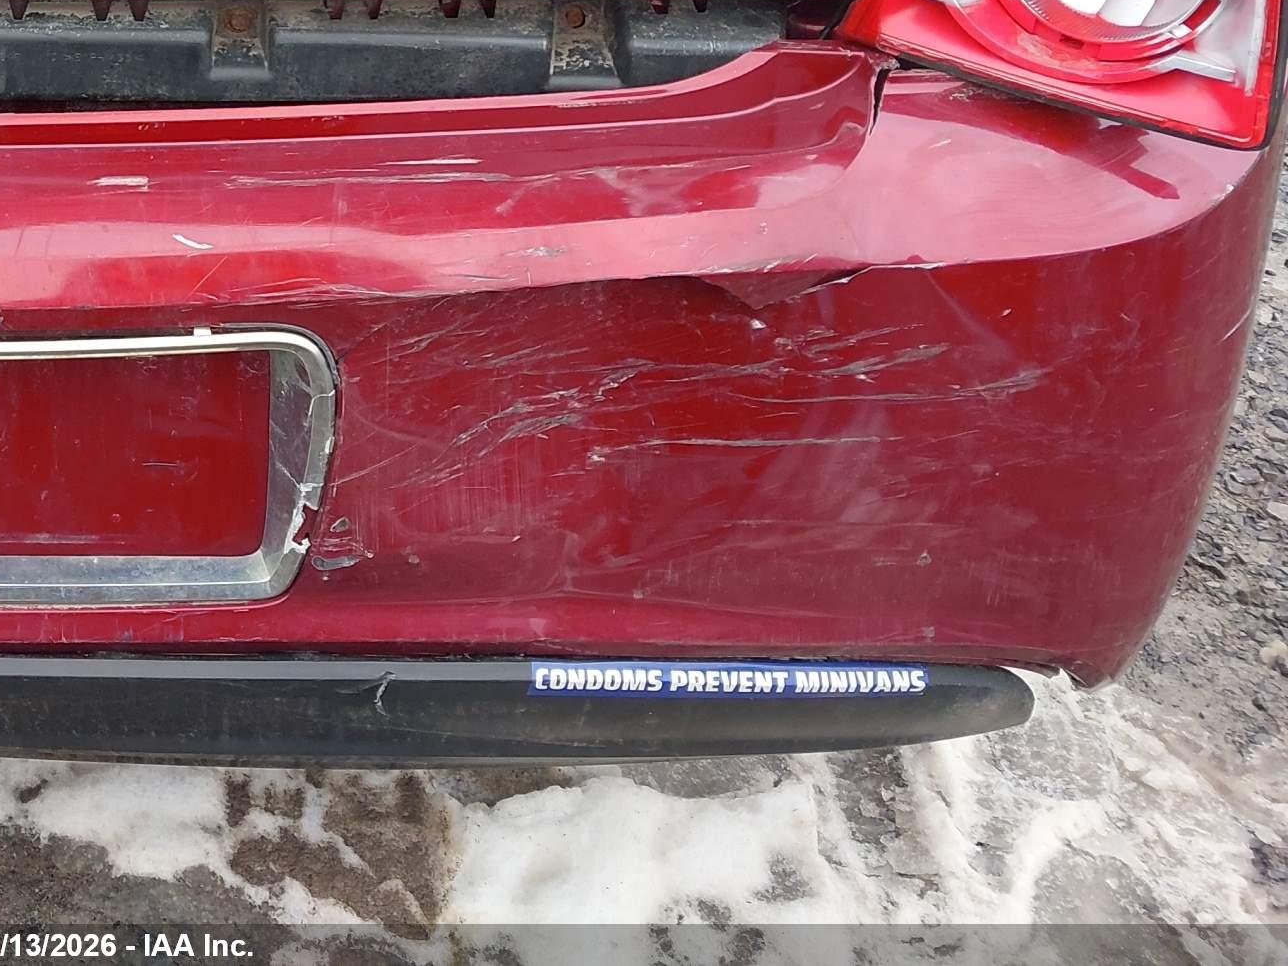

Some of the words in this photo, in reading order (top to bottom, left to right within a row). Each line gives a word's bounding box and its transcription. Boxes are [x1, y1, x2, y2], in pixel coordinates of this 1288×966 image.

[535, 668, 663, 692] CONDOMS
[669, 670, 789, 694] PREVENT
[794, 670, 927, 694] MINIVANS
